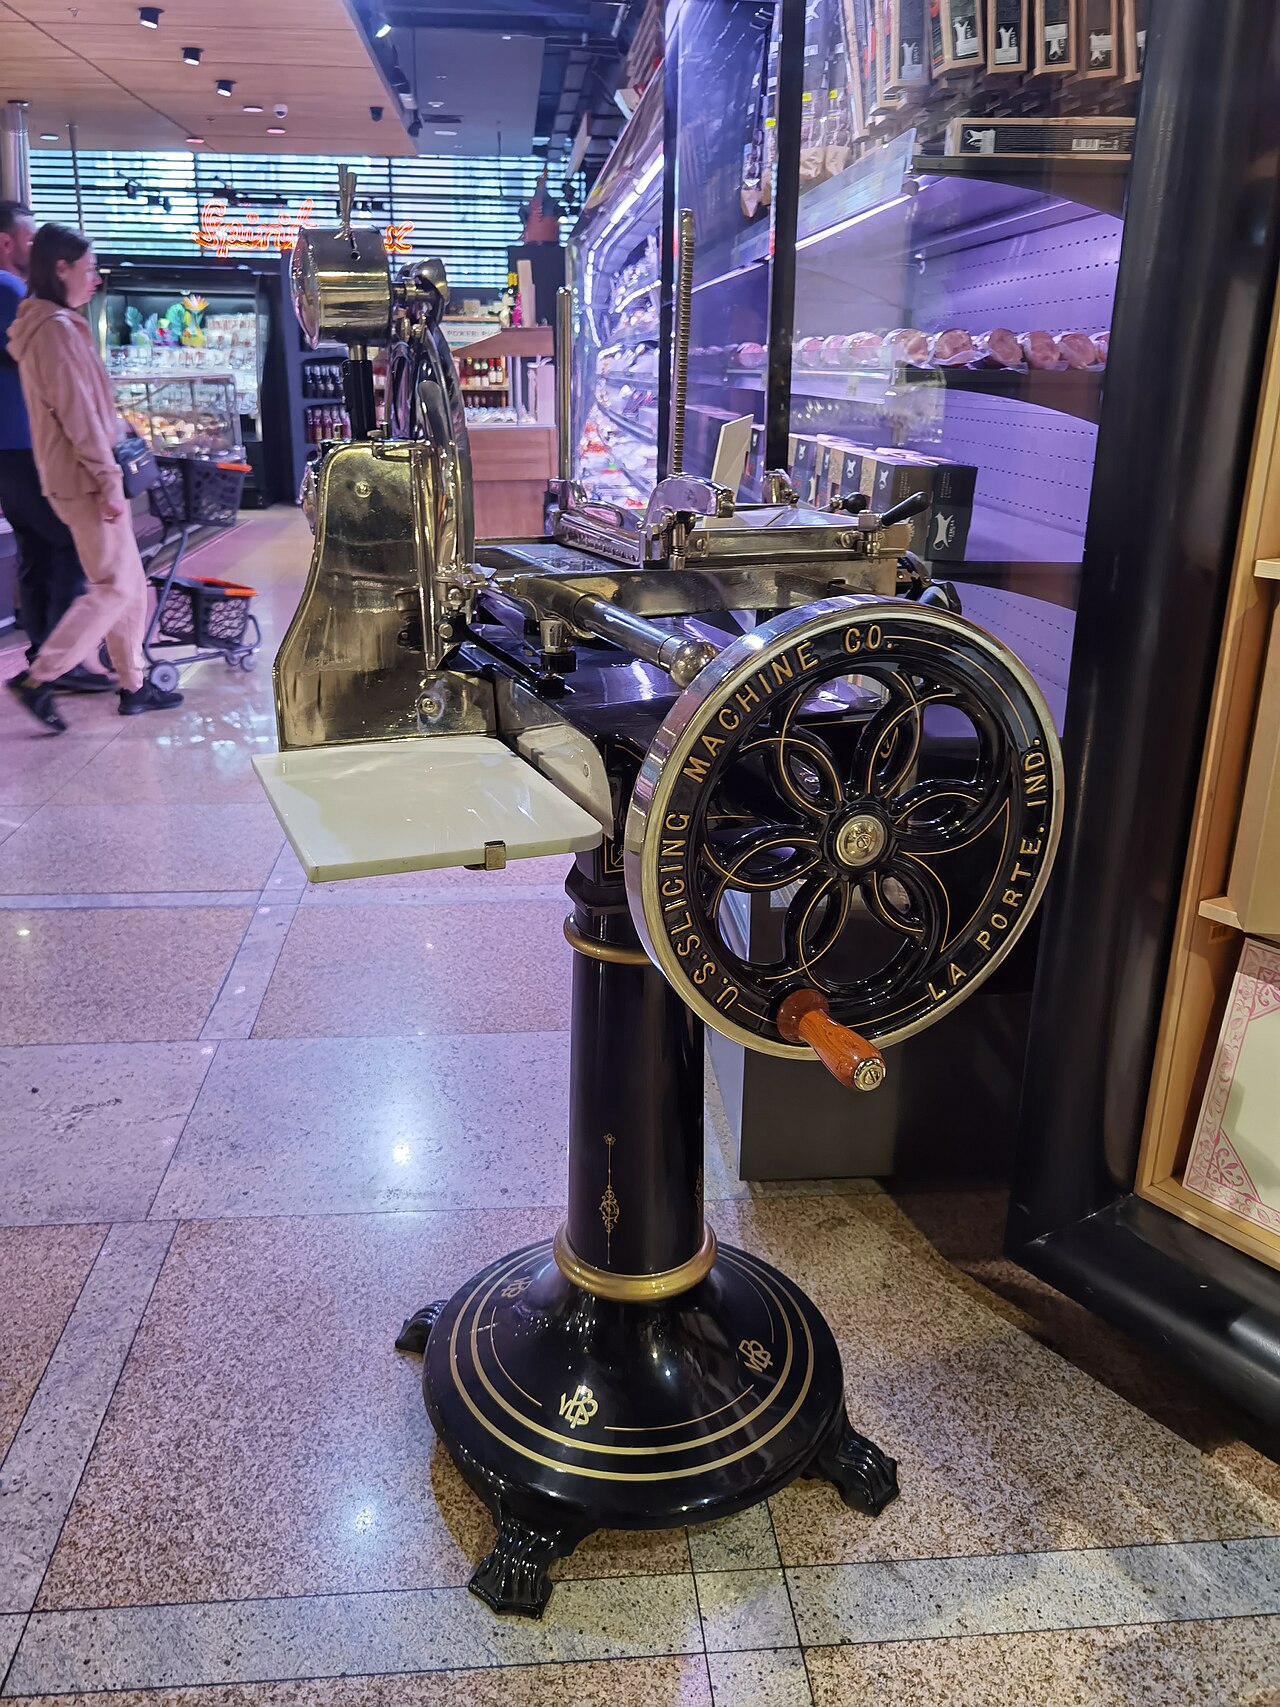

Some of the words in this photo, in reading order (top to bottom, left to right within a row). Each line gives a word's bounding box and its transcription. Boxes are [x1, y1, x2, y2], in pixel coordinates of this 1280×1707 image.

[658, 811, 701, 957] SLICING
[683, 642, 819, 784] MACHINE
[845, 625, 894, 654] CO.
[928, 964, 967, 1002] LA
[975, 825, 1045, 951] PORTE.
[1023, 738, 1047, 807] IND.
